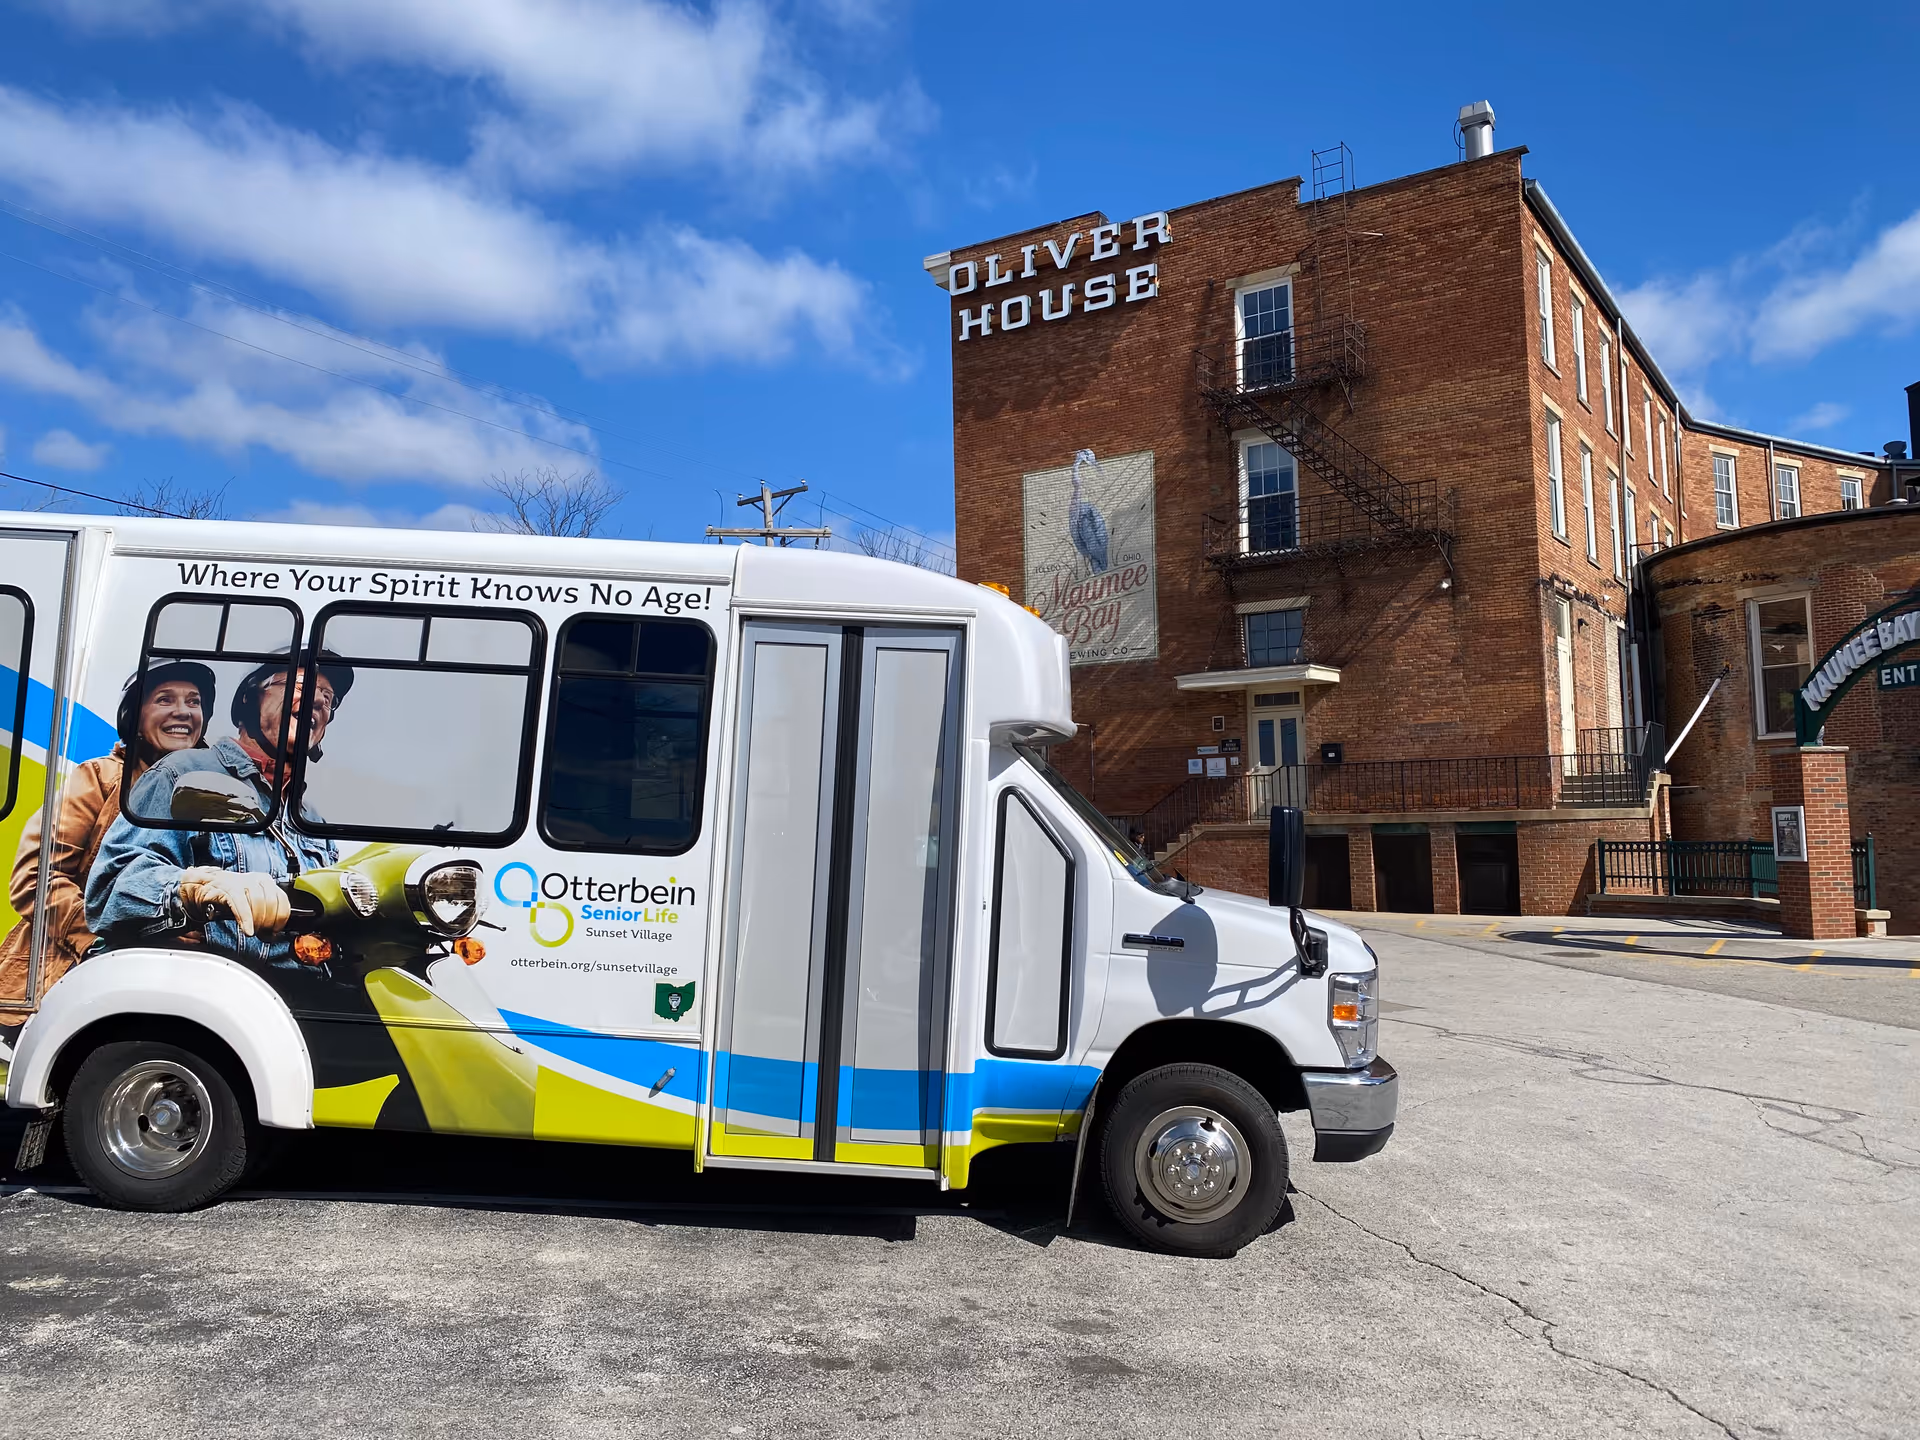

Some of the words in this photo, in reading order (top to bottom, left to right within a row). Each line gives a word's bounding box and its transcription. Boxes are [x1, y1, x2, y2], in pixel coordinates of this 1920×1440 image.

[949, 210, 1173, 296] OLIVER
[958, 263, 1160, 341] HOUSE
[1123, 552, 1142, 562] OHIO
[177, 562, 280, 589] Where
[289, 568, 362, 593] Your
[369, 572, 461, 601] Spirit
[470, 577, 579, 604] Knows
[590, 583, 633, 606] No
[641, 585, 711, 615] Age!
[1032, 563, 1149, 619] Maumee
[1062, 601, 1121, 648] Bay
[1069, 648, 1107, 660] EWING
[1801, 628, 1882, 711] MAUMEE
[1877, 611, 1920, 650] BAY
[541, 872, 696, 906] Otterbein
[585, 927, 628, 939] Sunset
[630, 929, 673, 943] Village
[510, 957, 678, 977] otterbein.org/sunsetvillage
